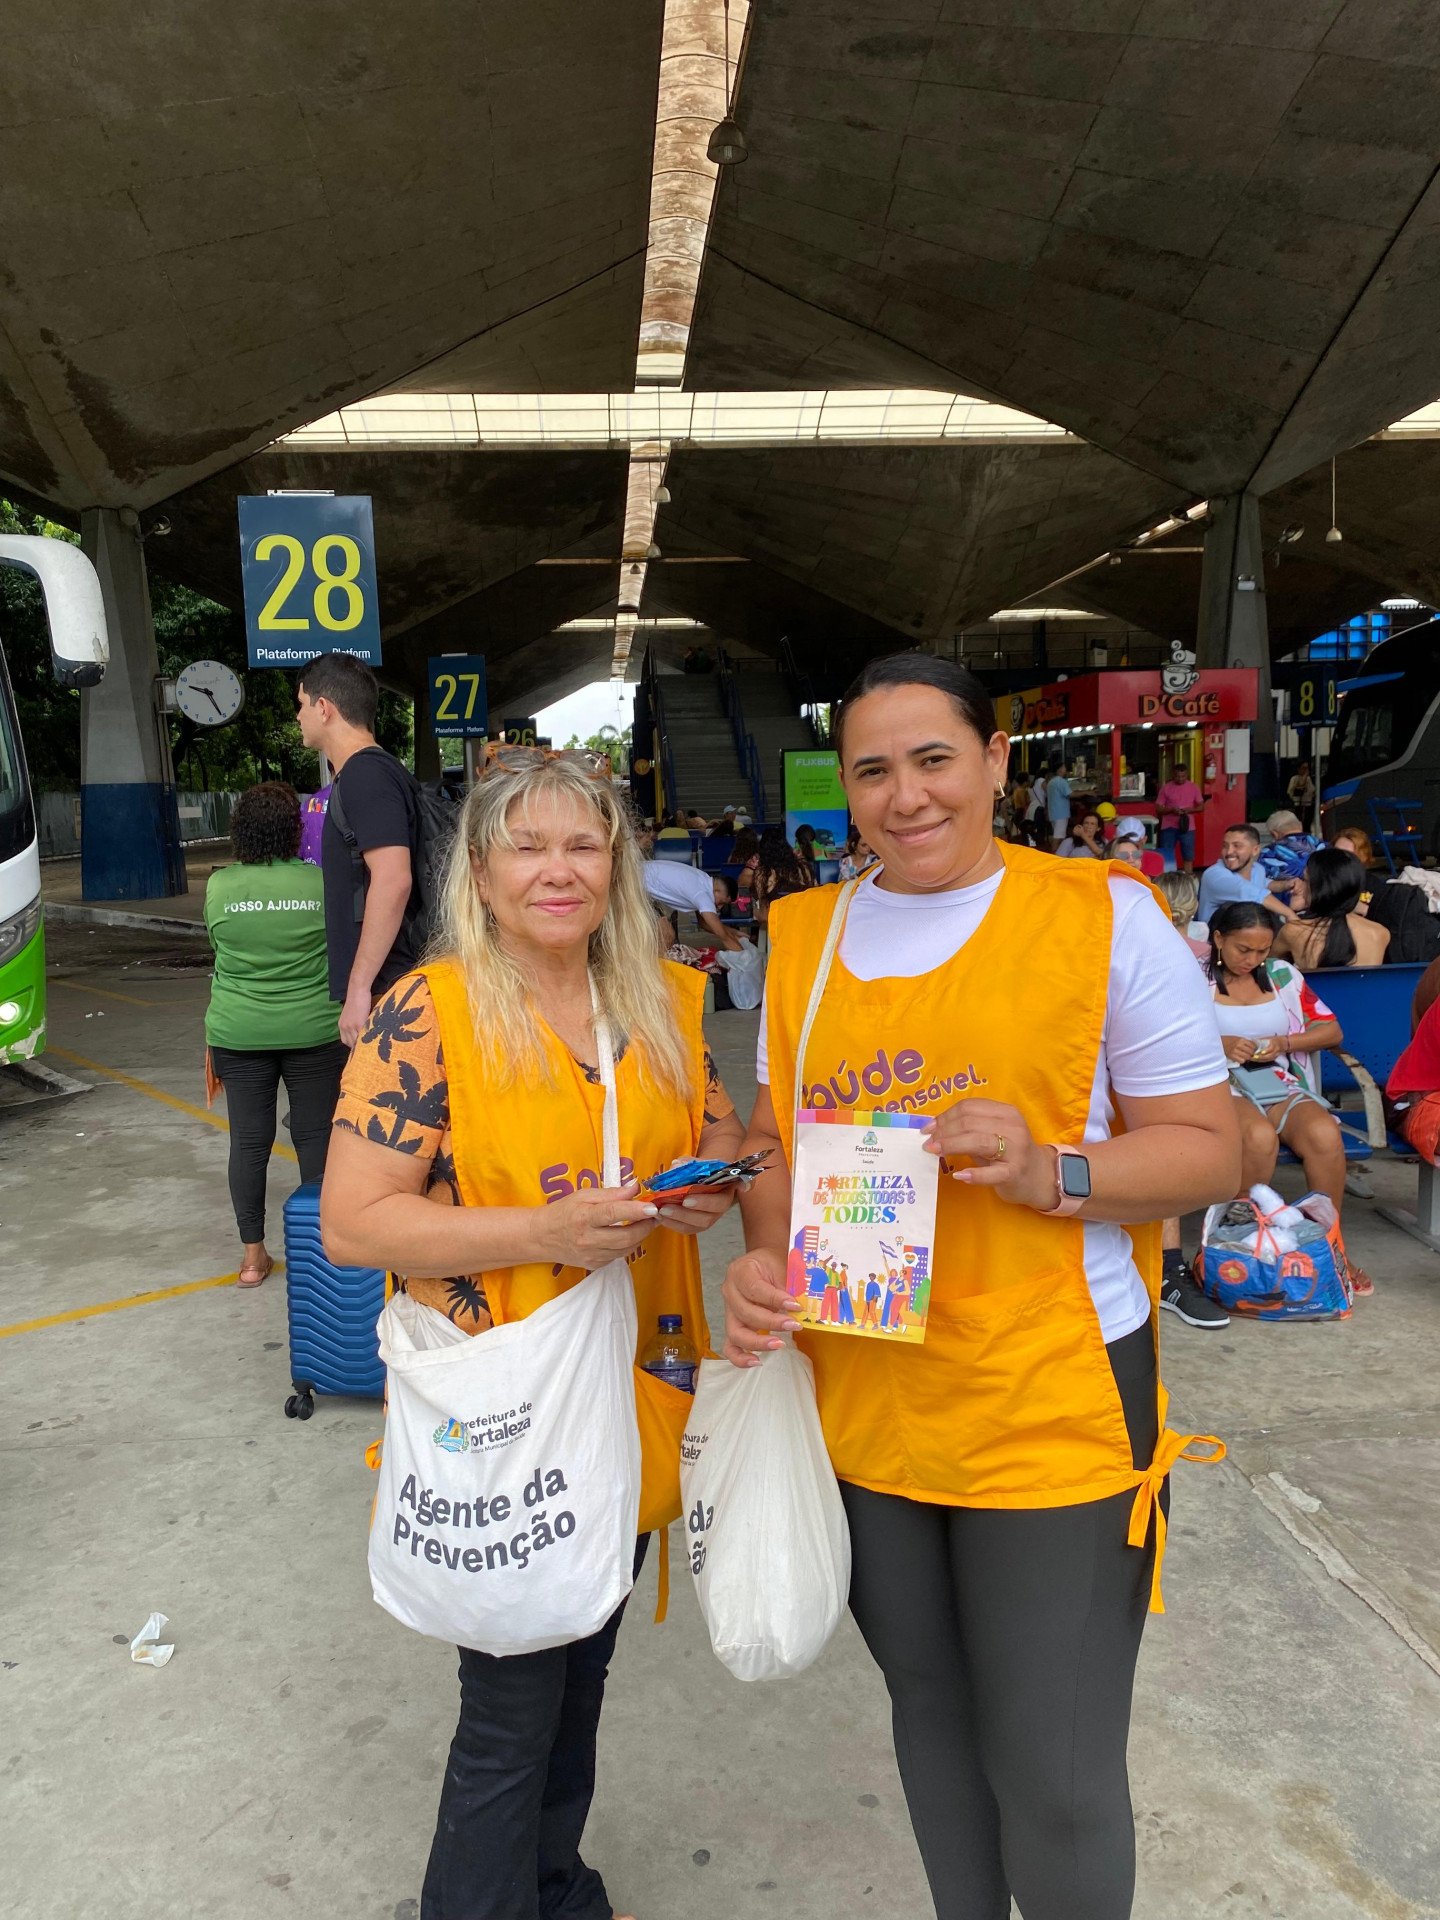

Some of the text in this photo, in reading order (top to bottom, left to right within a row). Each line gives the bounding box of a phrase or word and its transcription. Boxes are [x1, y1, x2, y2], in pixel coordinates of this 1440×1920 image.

[255, 534, 365, 631] 28
[256, 648, 322, 660] Plataforma
[435, 673, 480, 720] 27
[1140, 693, 1220, 716] D'Café
[1300, 681, 1314, 716] 8
[1328, 679, 1335, 715] 8
[507, 728, 536, 747] 26
[796, 757, 835, 766] FLIXBUS
[223, 900, 322, 914] POSSO AJUDAR?
[855, 1145, 884, 1154] Fortaleza
[812, 1191, 829, 1205] DE
[822, 1206, 900, 1224] TODES.
[519, 1402, 533, 1414] de
[470, 1417, 531, 1447] ortaleza
[399, 1467, 568, 1528] Agente da
[689, 1500, 714, 1533] da
[393, 1510, 576, 1573] Prevenção
